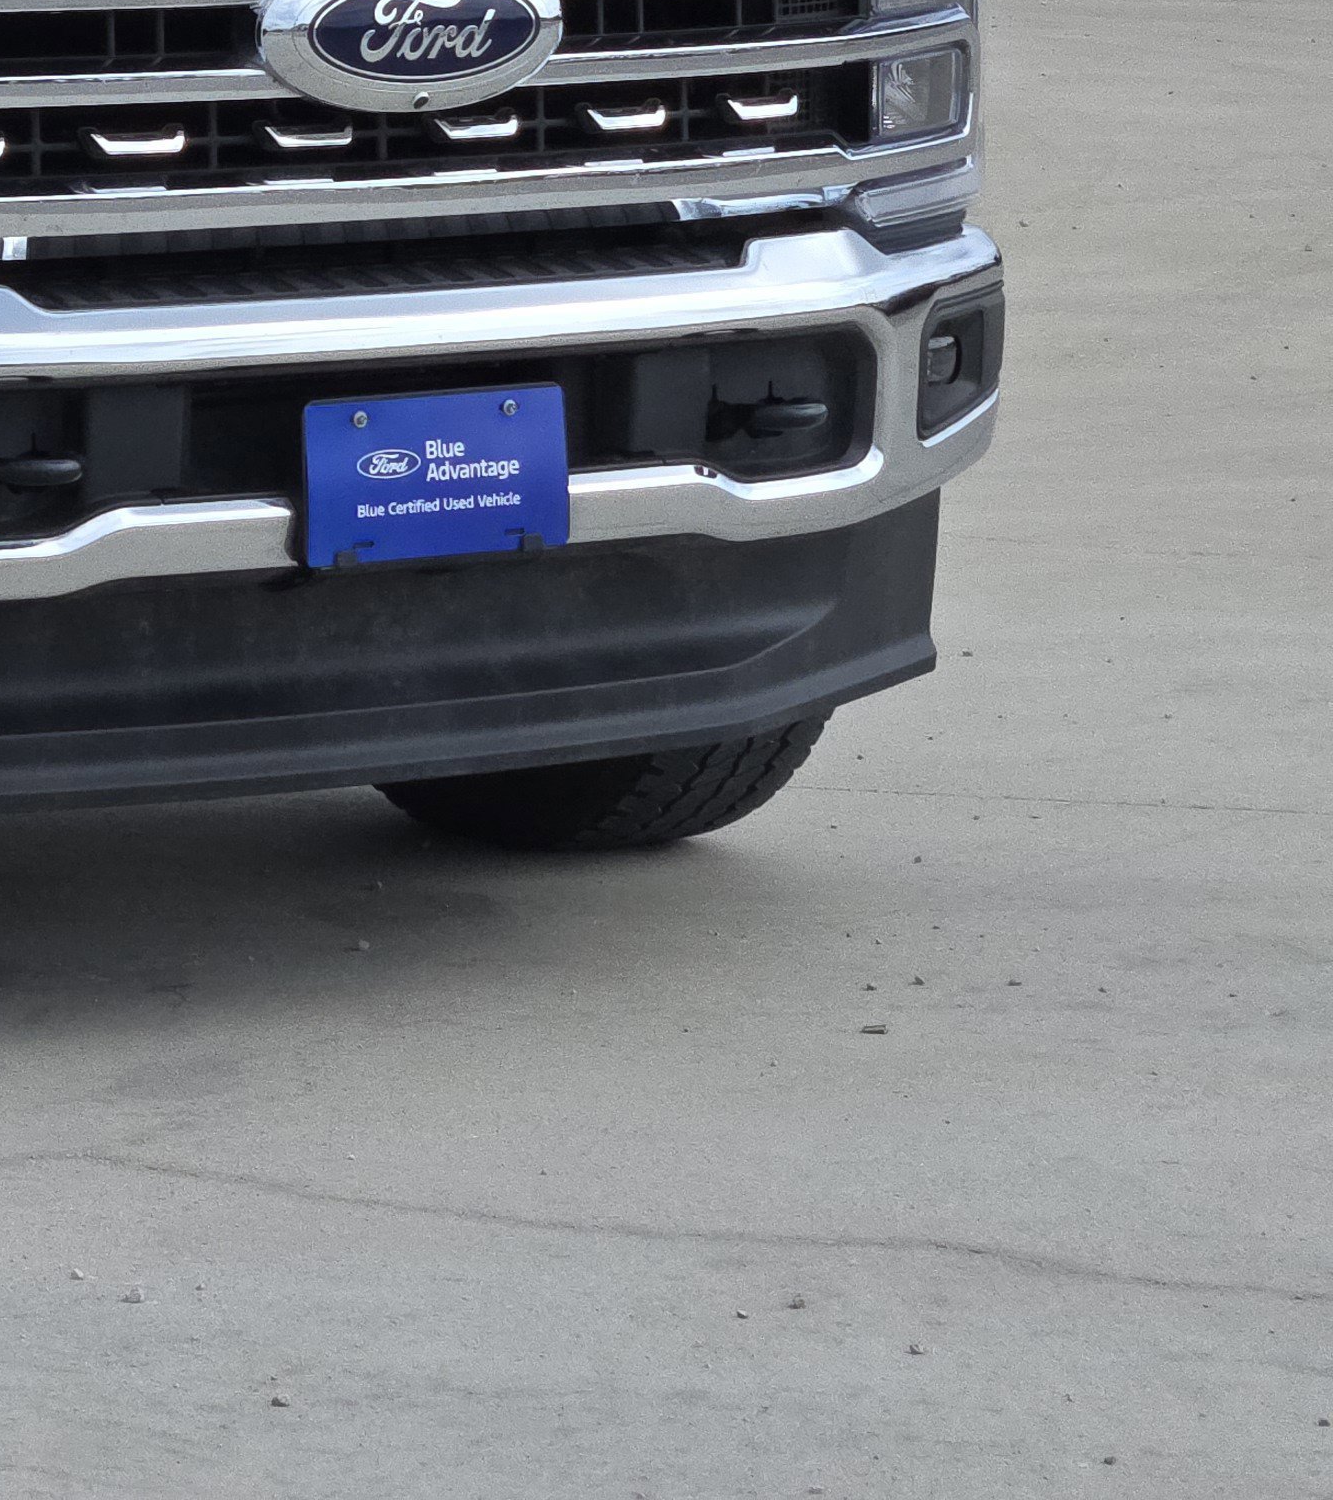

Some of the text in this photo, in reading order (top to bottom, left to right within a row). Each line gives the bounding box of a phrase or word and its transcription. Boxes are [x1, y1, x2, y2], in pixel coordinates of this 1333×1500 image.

[425, 440, 465, 460] Blue
[369, 453, 409, 475] Ford
[426, 459, 520, 482] Advantage
[357, 491, 522, 519] Blue Certified Used Vehicle
